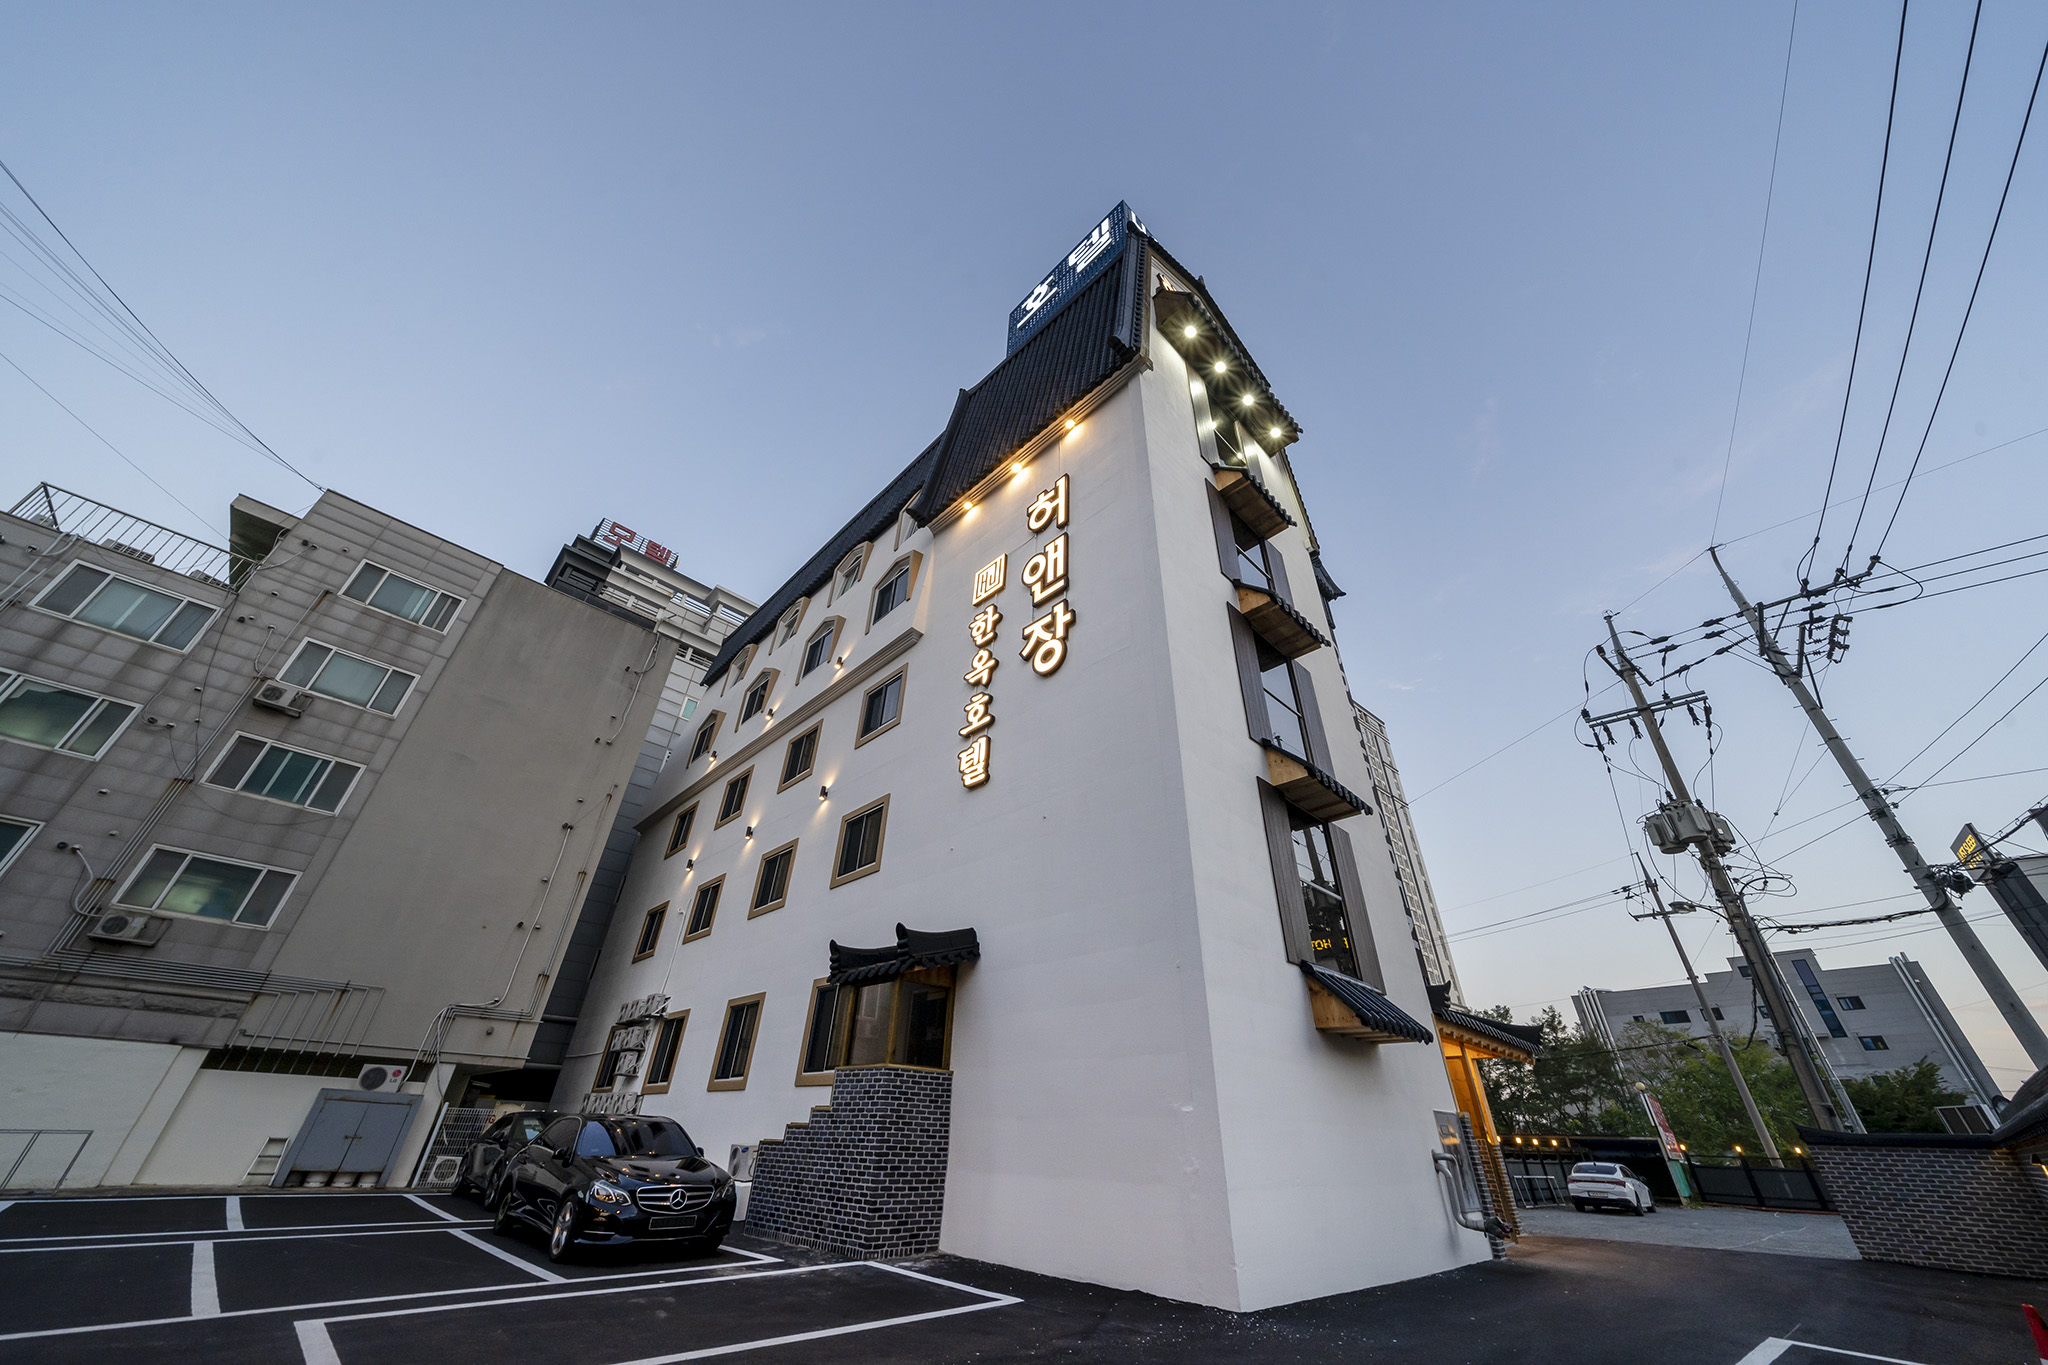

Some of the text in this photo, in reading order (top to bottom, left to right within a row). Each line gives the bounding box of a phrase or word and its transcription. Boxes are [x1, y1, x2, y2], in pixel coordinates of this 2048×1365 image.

[1017, 217, 1113, 324] 호텔
[603, 521, 672, 566] 모텔
[1019, 473, 1076, 677] 허앤장
[958, 604, 1003, 790] 한옥호텔
